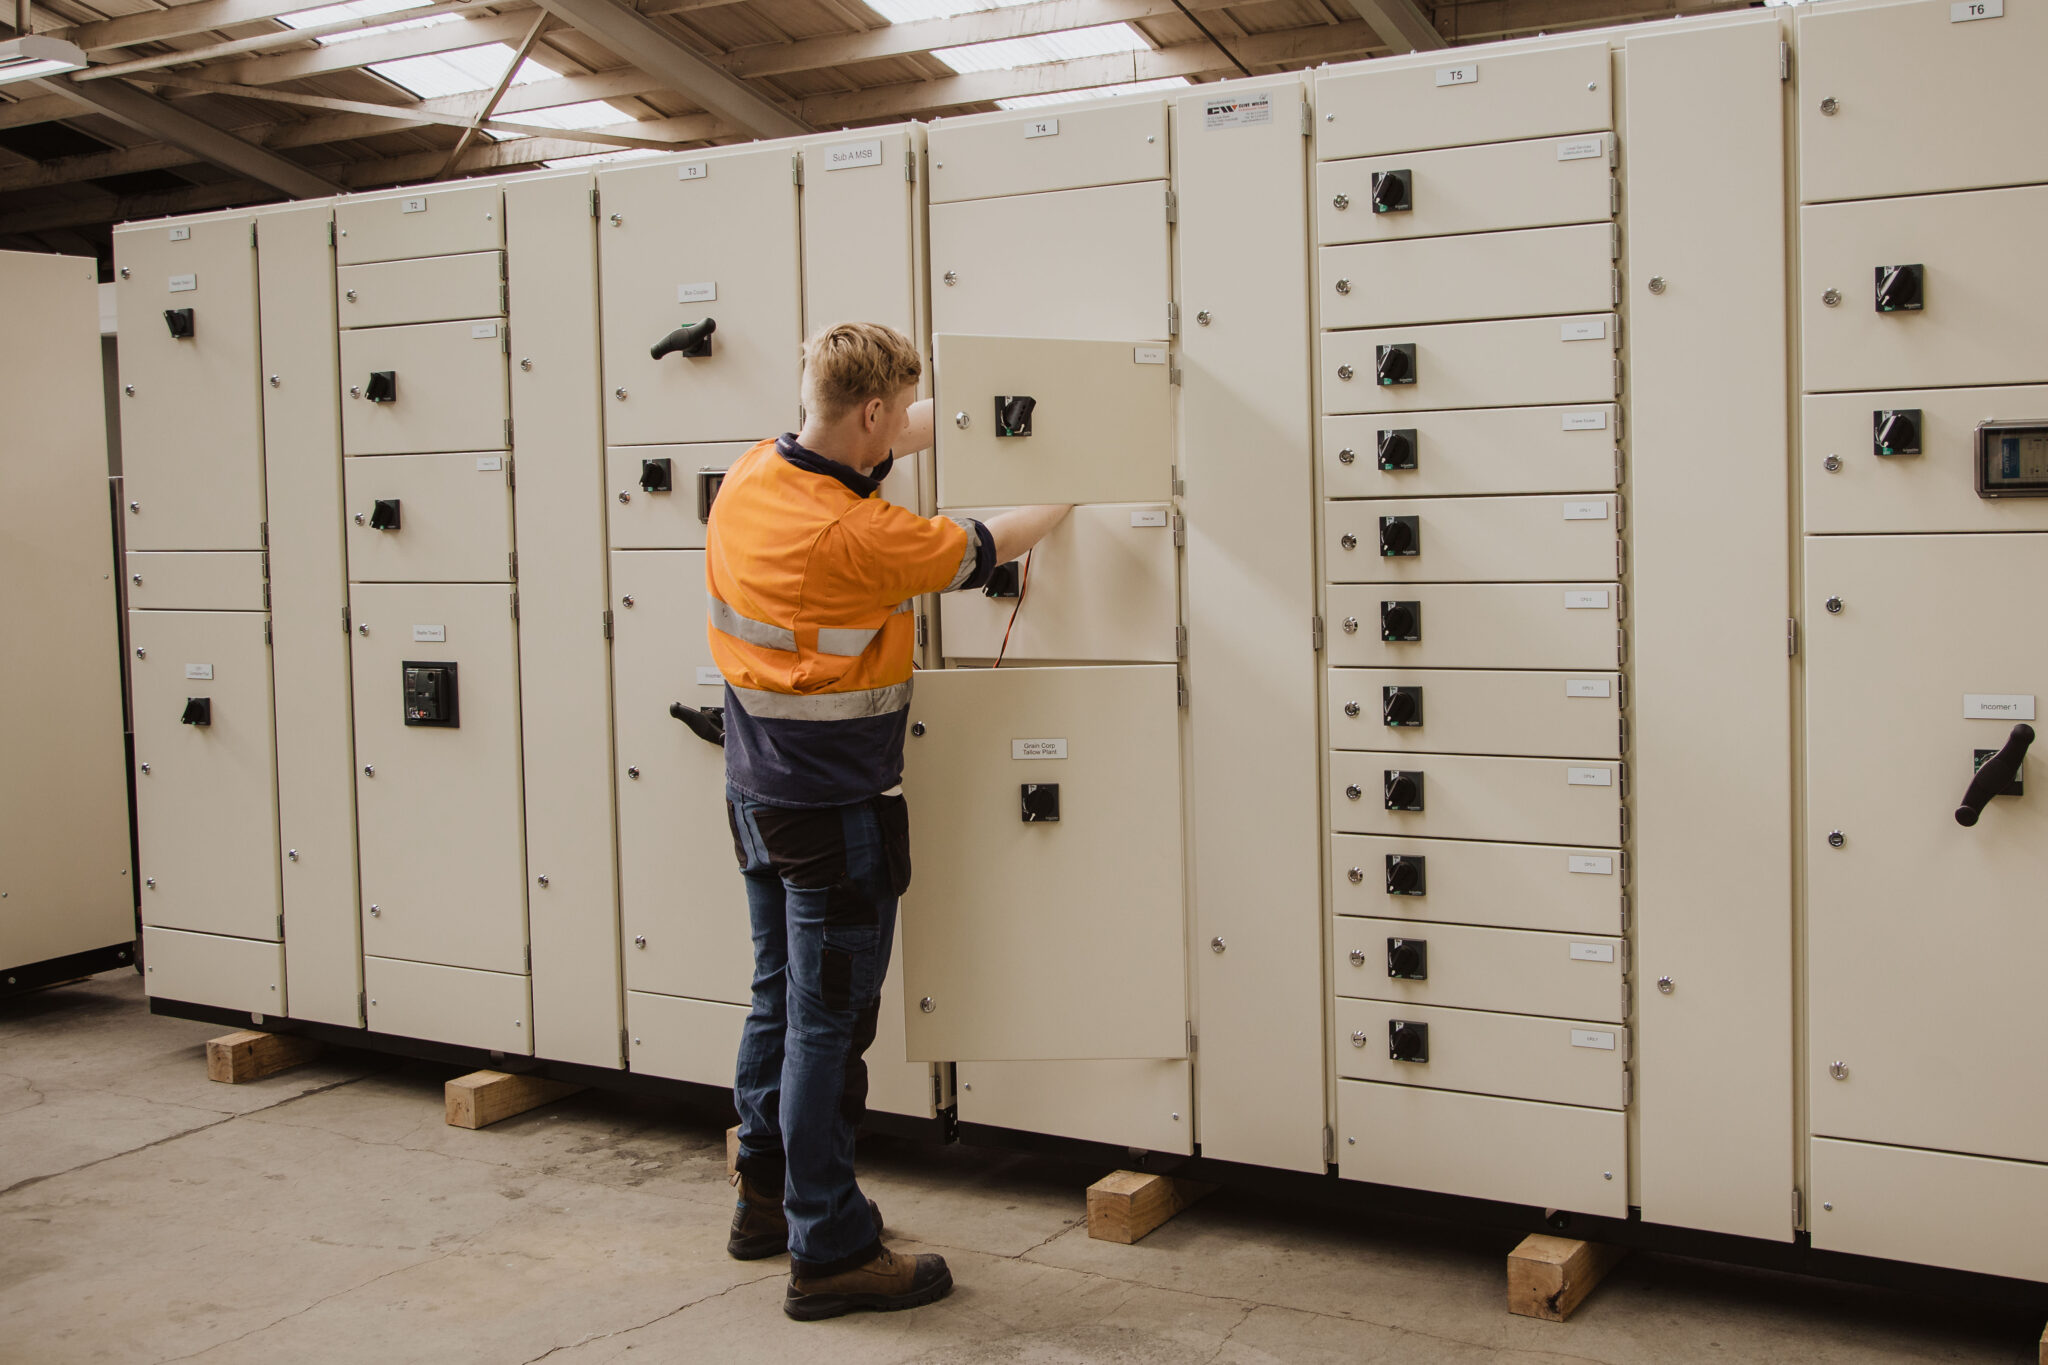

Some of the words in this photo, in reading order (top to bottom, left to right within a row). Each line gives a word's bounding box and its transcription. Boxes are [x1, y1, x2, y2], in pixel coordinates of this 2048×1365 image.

[1969, 4, 1985, 16] T6
[1450, 71, 1463, 80] T5
[1035, 124, 1046, 133] T4
[833, 152, 849, 162] Sub
[849, 151, 854, 160] A
[855, 149, 873, 159] MSB
[688, 168, 696, 176] T3
[410, 202, 418, 210] T2
[176, 230, 183, 238] T1
[1041, 742, 1056, 750] Corp
